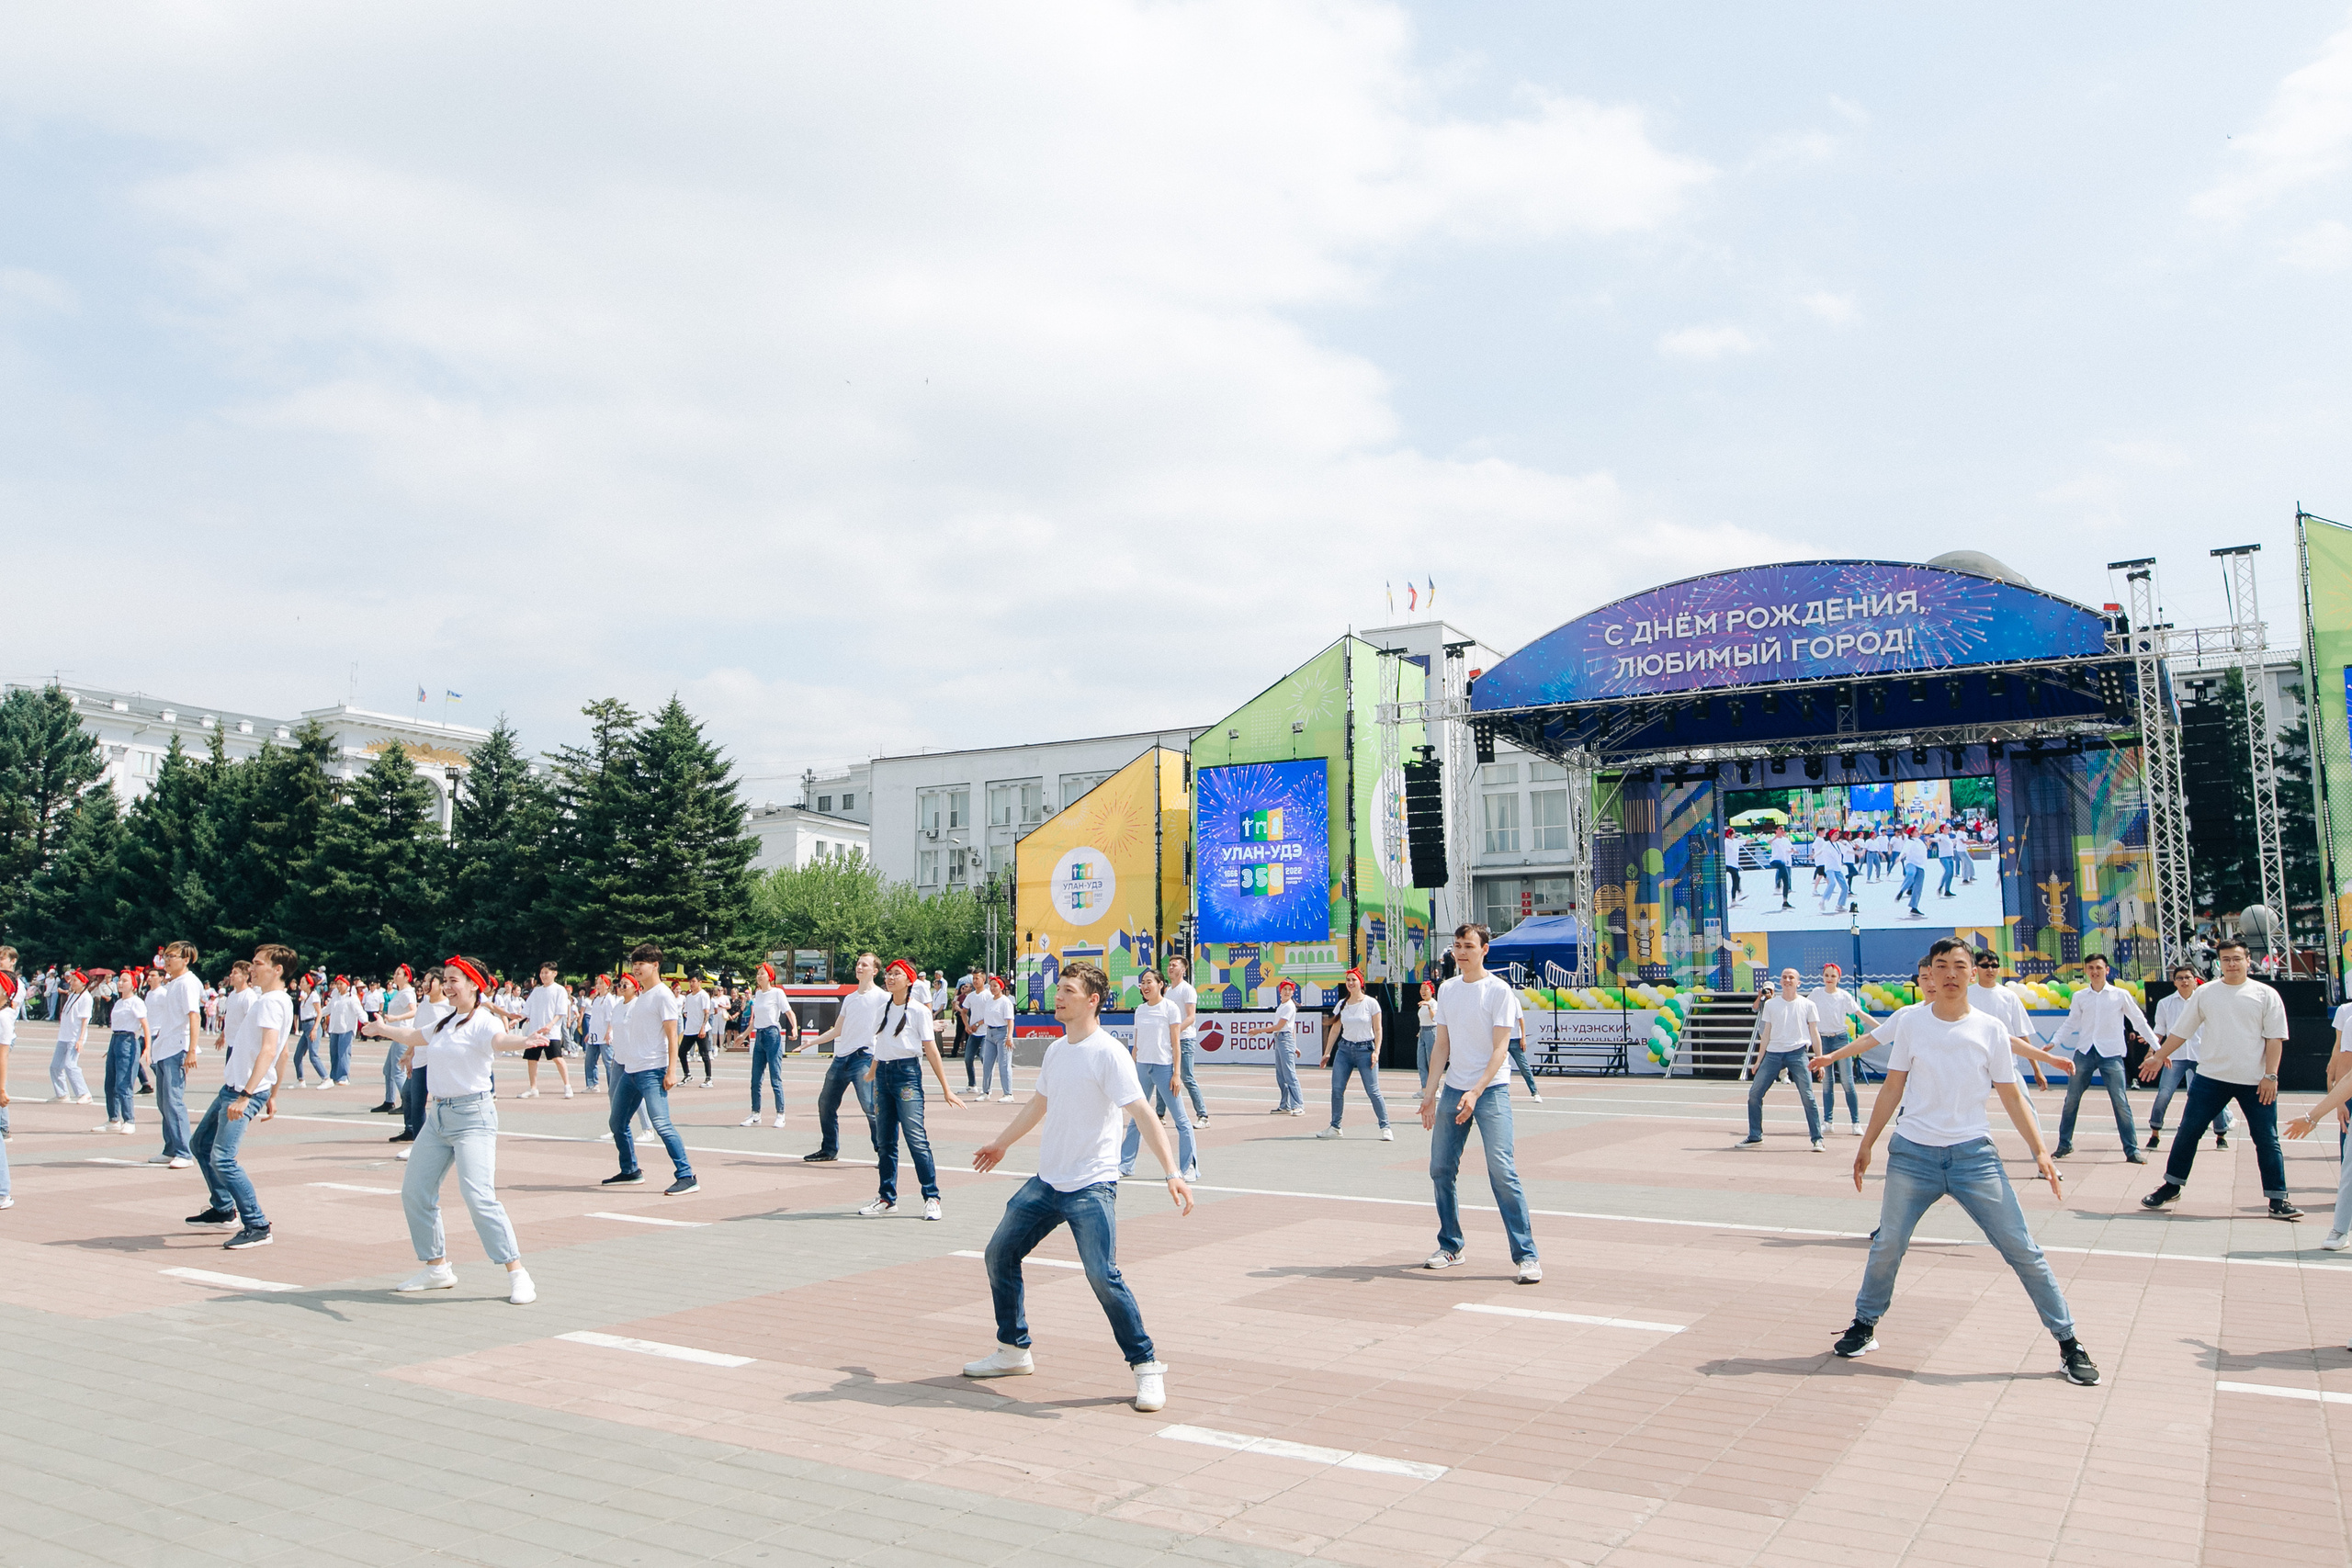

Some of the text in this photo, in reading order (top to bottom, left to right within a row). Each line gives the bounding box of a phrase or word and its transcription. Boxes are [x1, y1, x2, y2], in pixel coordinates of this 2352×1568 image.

[1604, 590, 1927, 647] С ДНЁМ РОЖДЕНИЯ,
[1614, 628, 1914, 680] ЛЮБИМЫЙ ГОРОД!
[1221, 843, 1303, 862] УЛАН-УДЭ
[1063, 881, 1103, 890] УЛАН-УДЭ
[807, 1019, 815, 1029] 4
[1231, 1021, 1314, 1034] ВЕРТОТЫ
[1539, 1022, 1632, 1033] УЛАН-УДЭНСКИЙ
